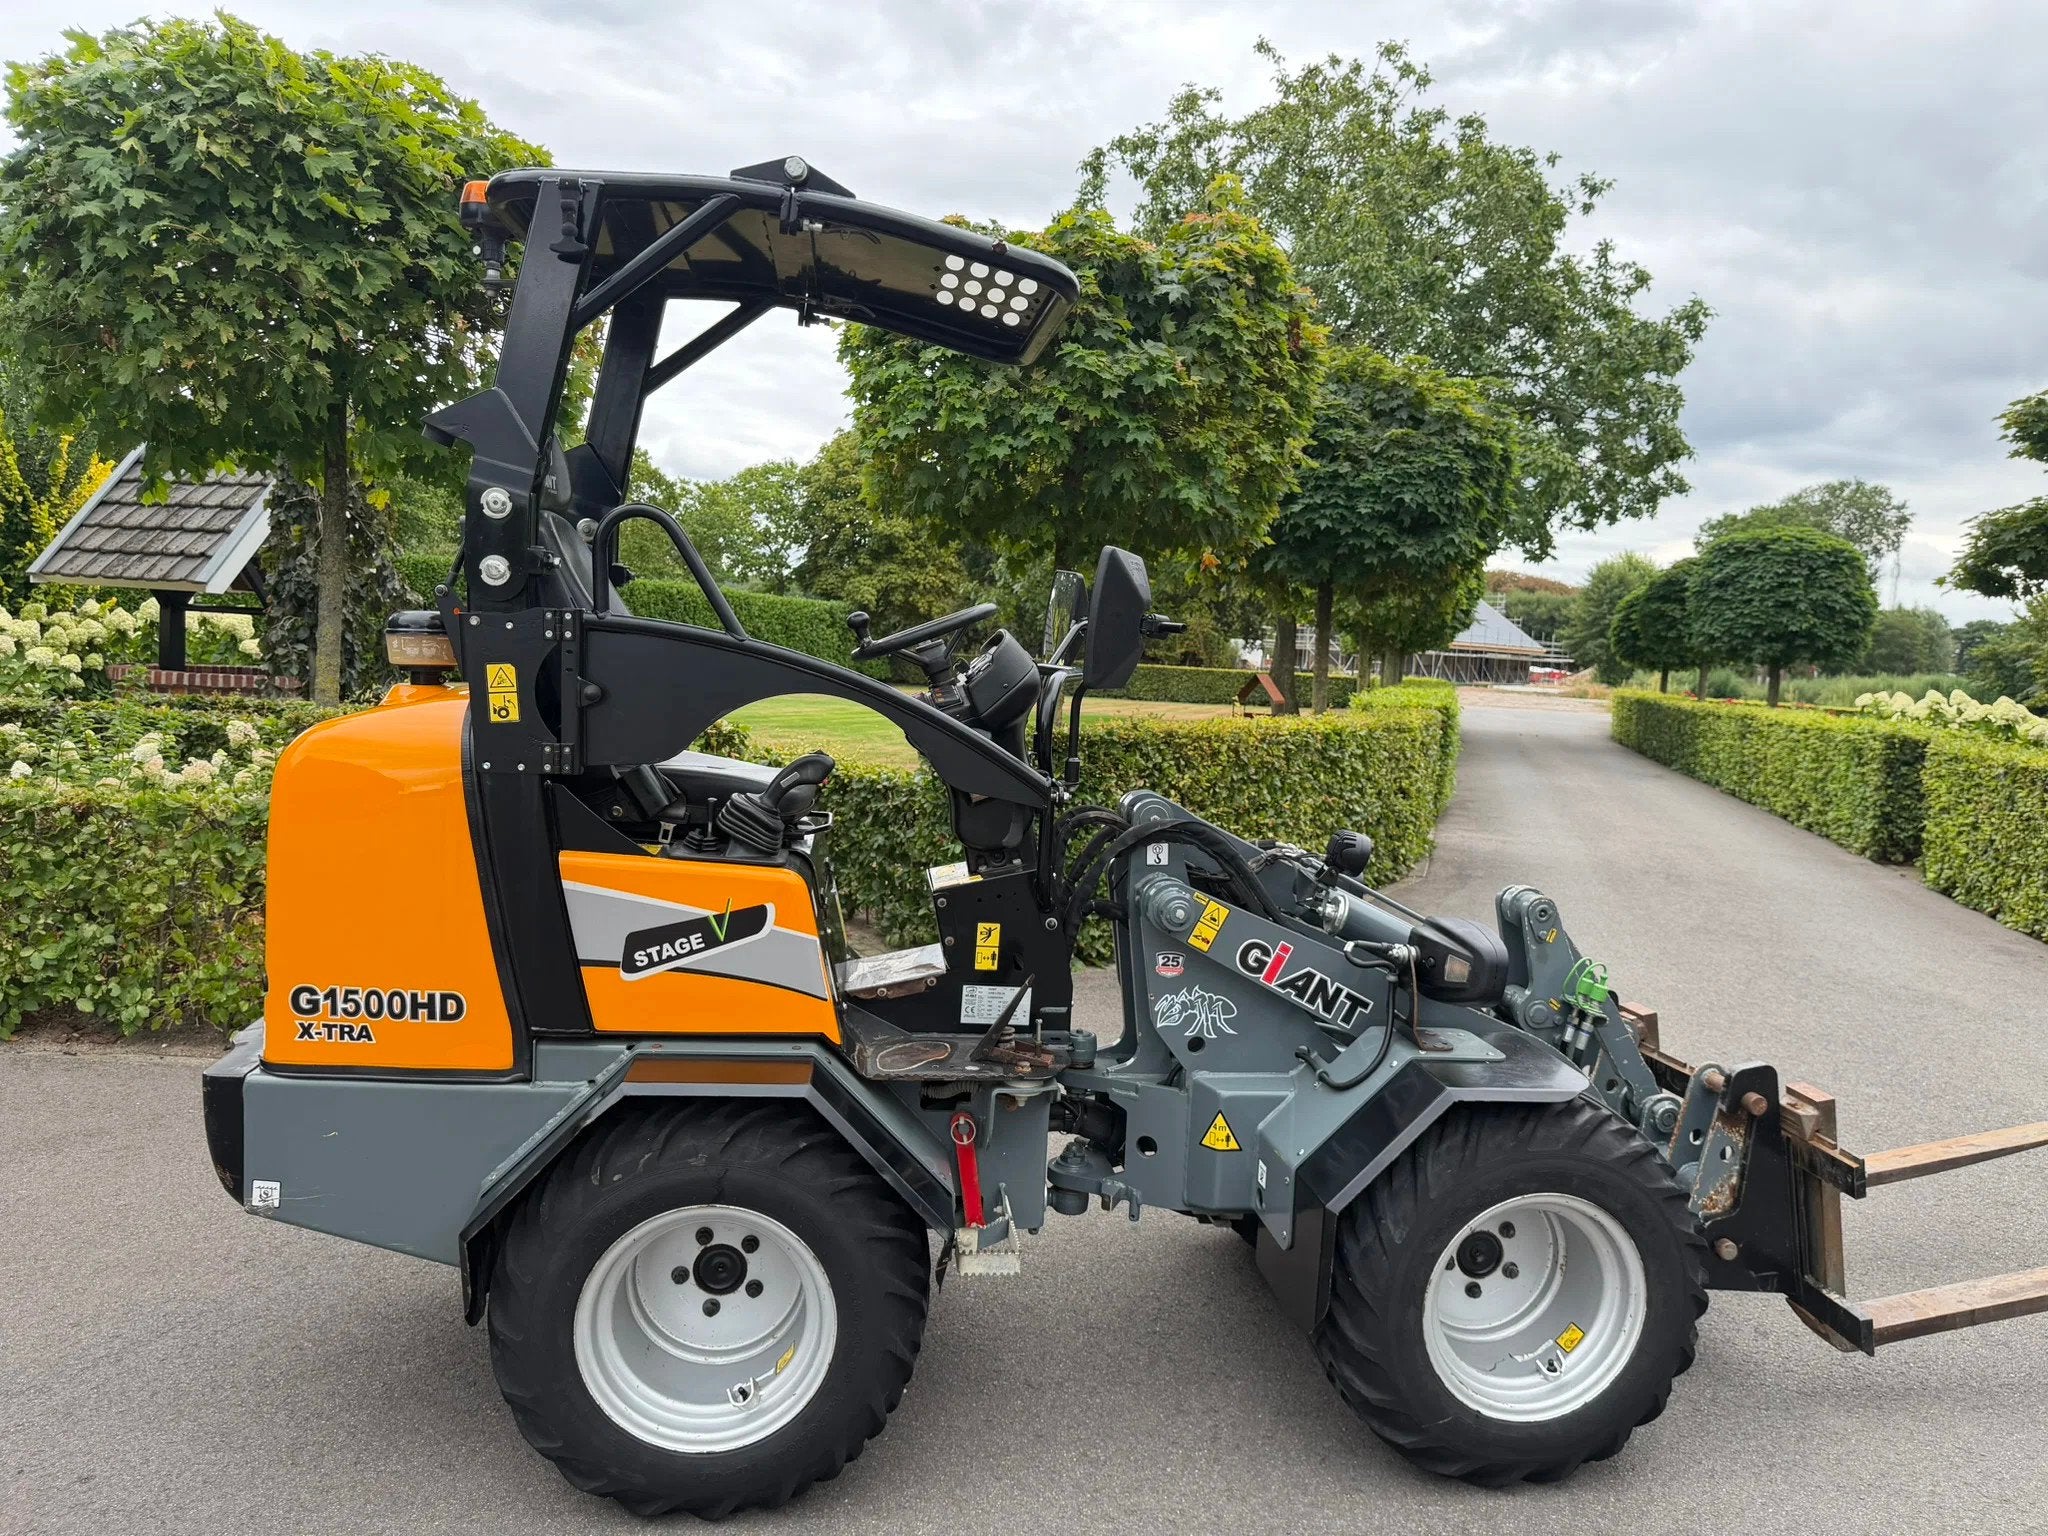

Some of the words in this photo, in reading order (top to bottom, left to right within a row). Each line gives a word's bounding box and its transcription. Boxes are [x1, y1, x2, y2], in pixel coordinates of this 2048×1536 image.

[634, 932, 706, 967] STAGE
[1161, 955, 1180, 967] 25
[289, 984, 467, 1023] G1500HD
[295, 1020, 376, 1043] X-TRA
